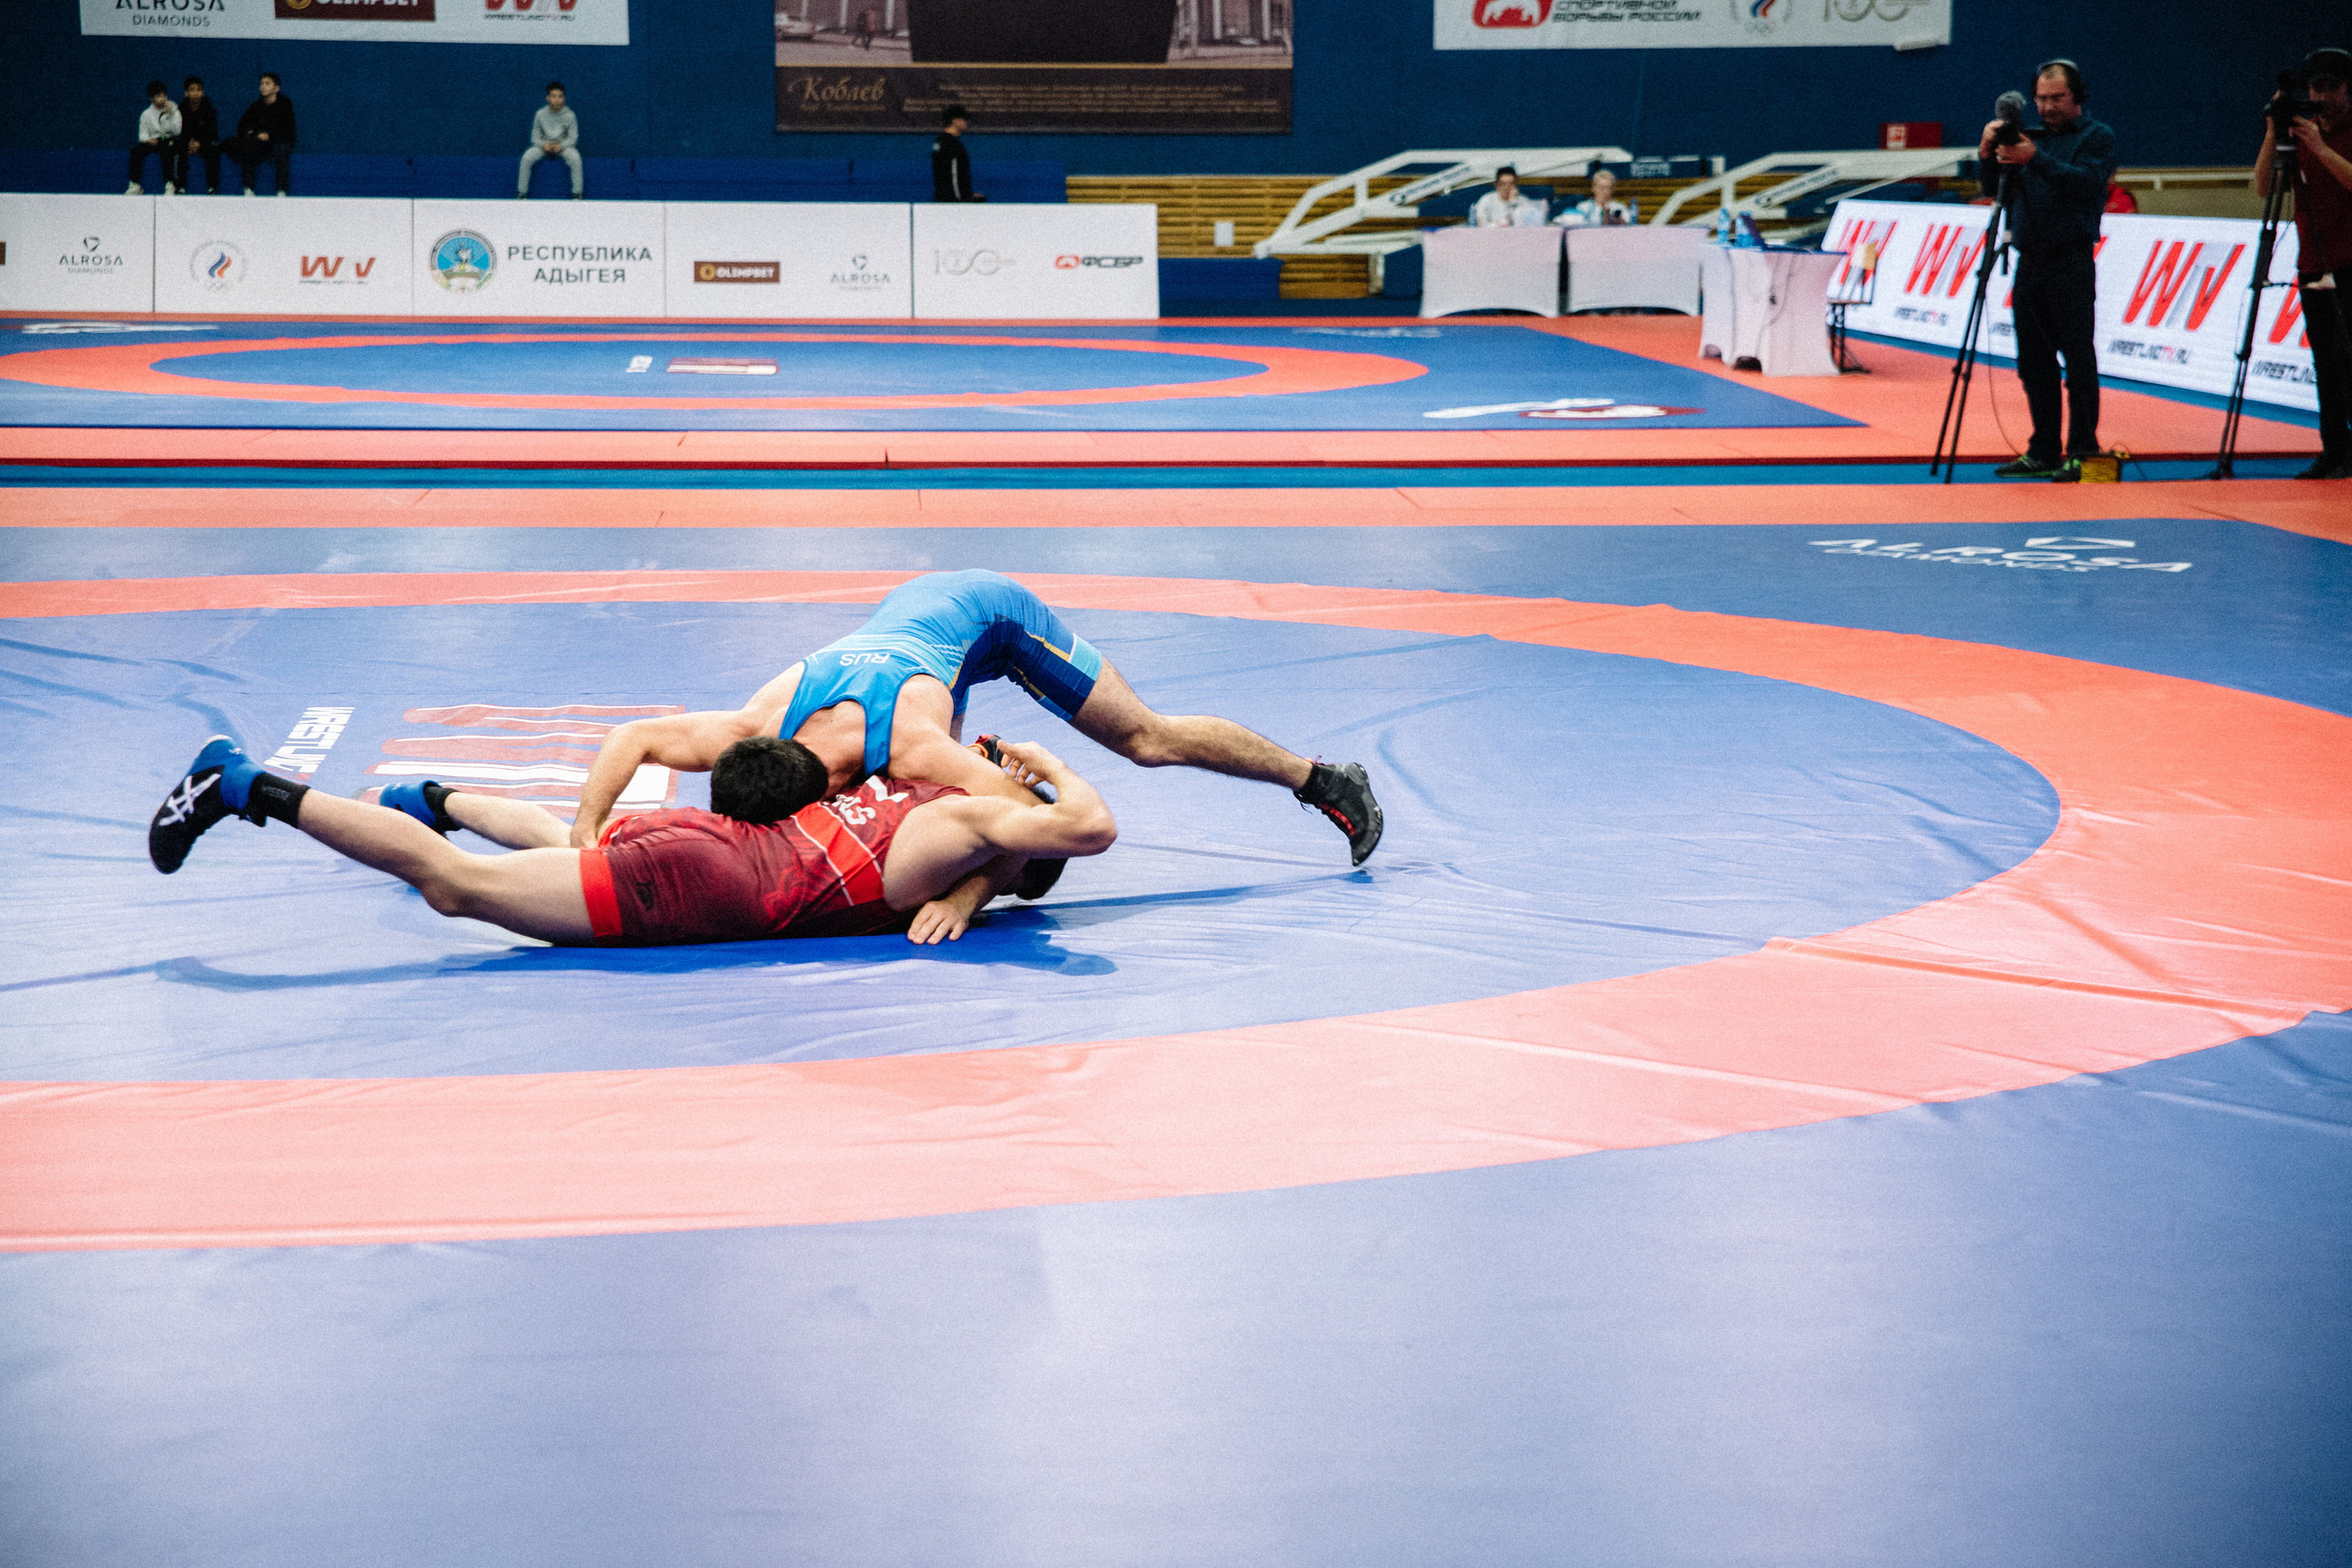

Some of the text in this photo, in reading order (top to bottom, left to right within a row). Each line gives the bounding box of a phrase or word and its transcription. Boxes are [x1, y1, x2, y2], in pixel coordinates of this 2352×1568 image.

[132, 14, 210, 28] DIAMONDS
[59, 254, 124, 266] ALROSA
[507, 245, 653, 262] РЕСПУБЛИКА
[534, 267, 627, 285] АДЫГЕЯ
[839, 653, 891, 667] RUS
